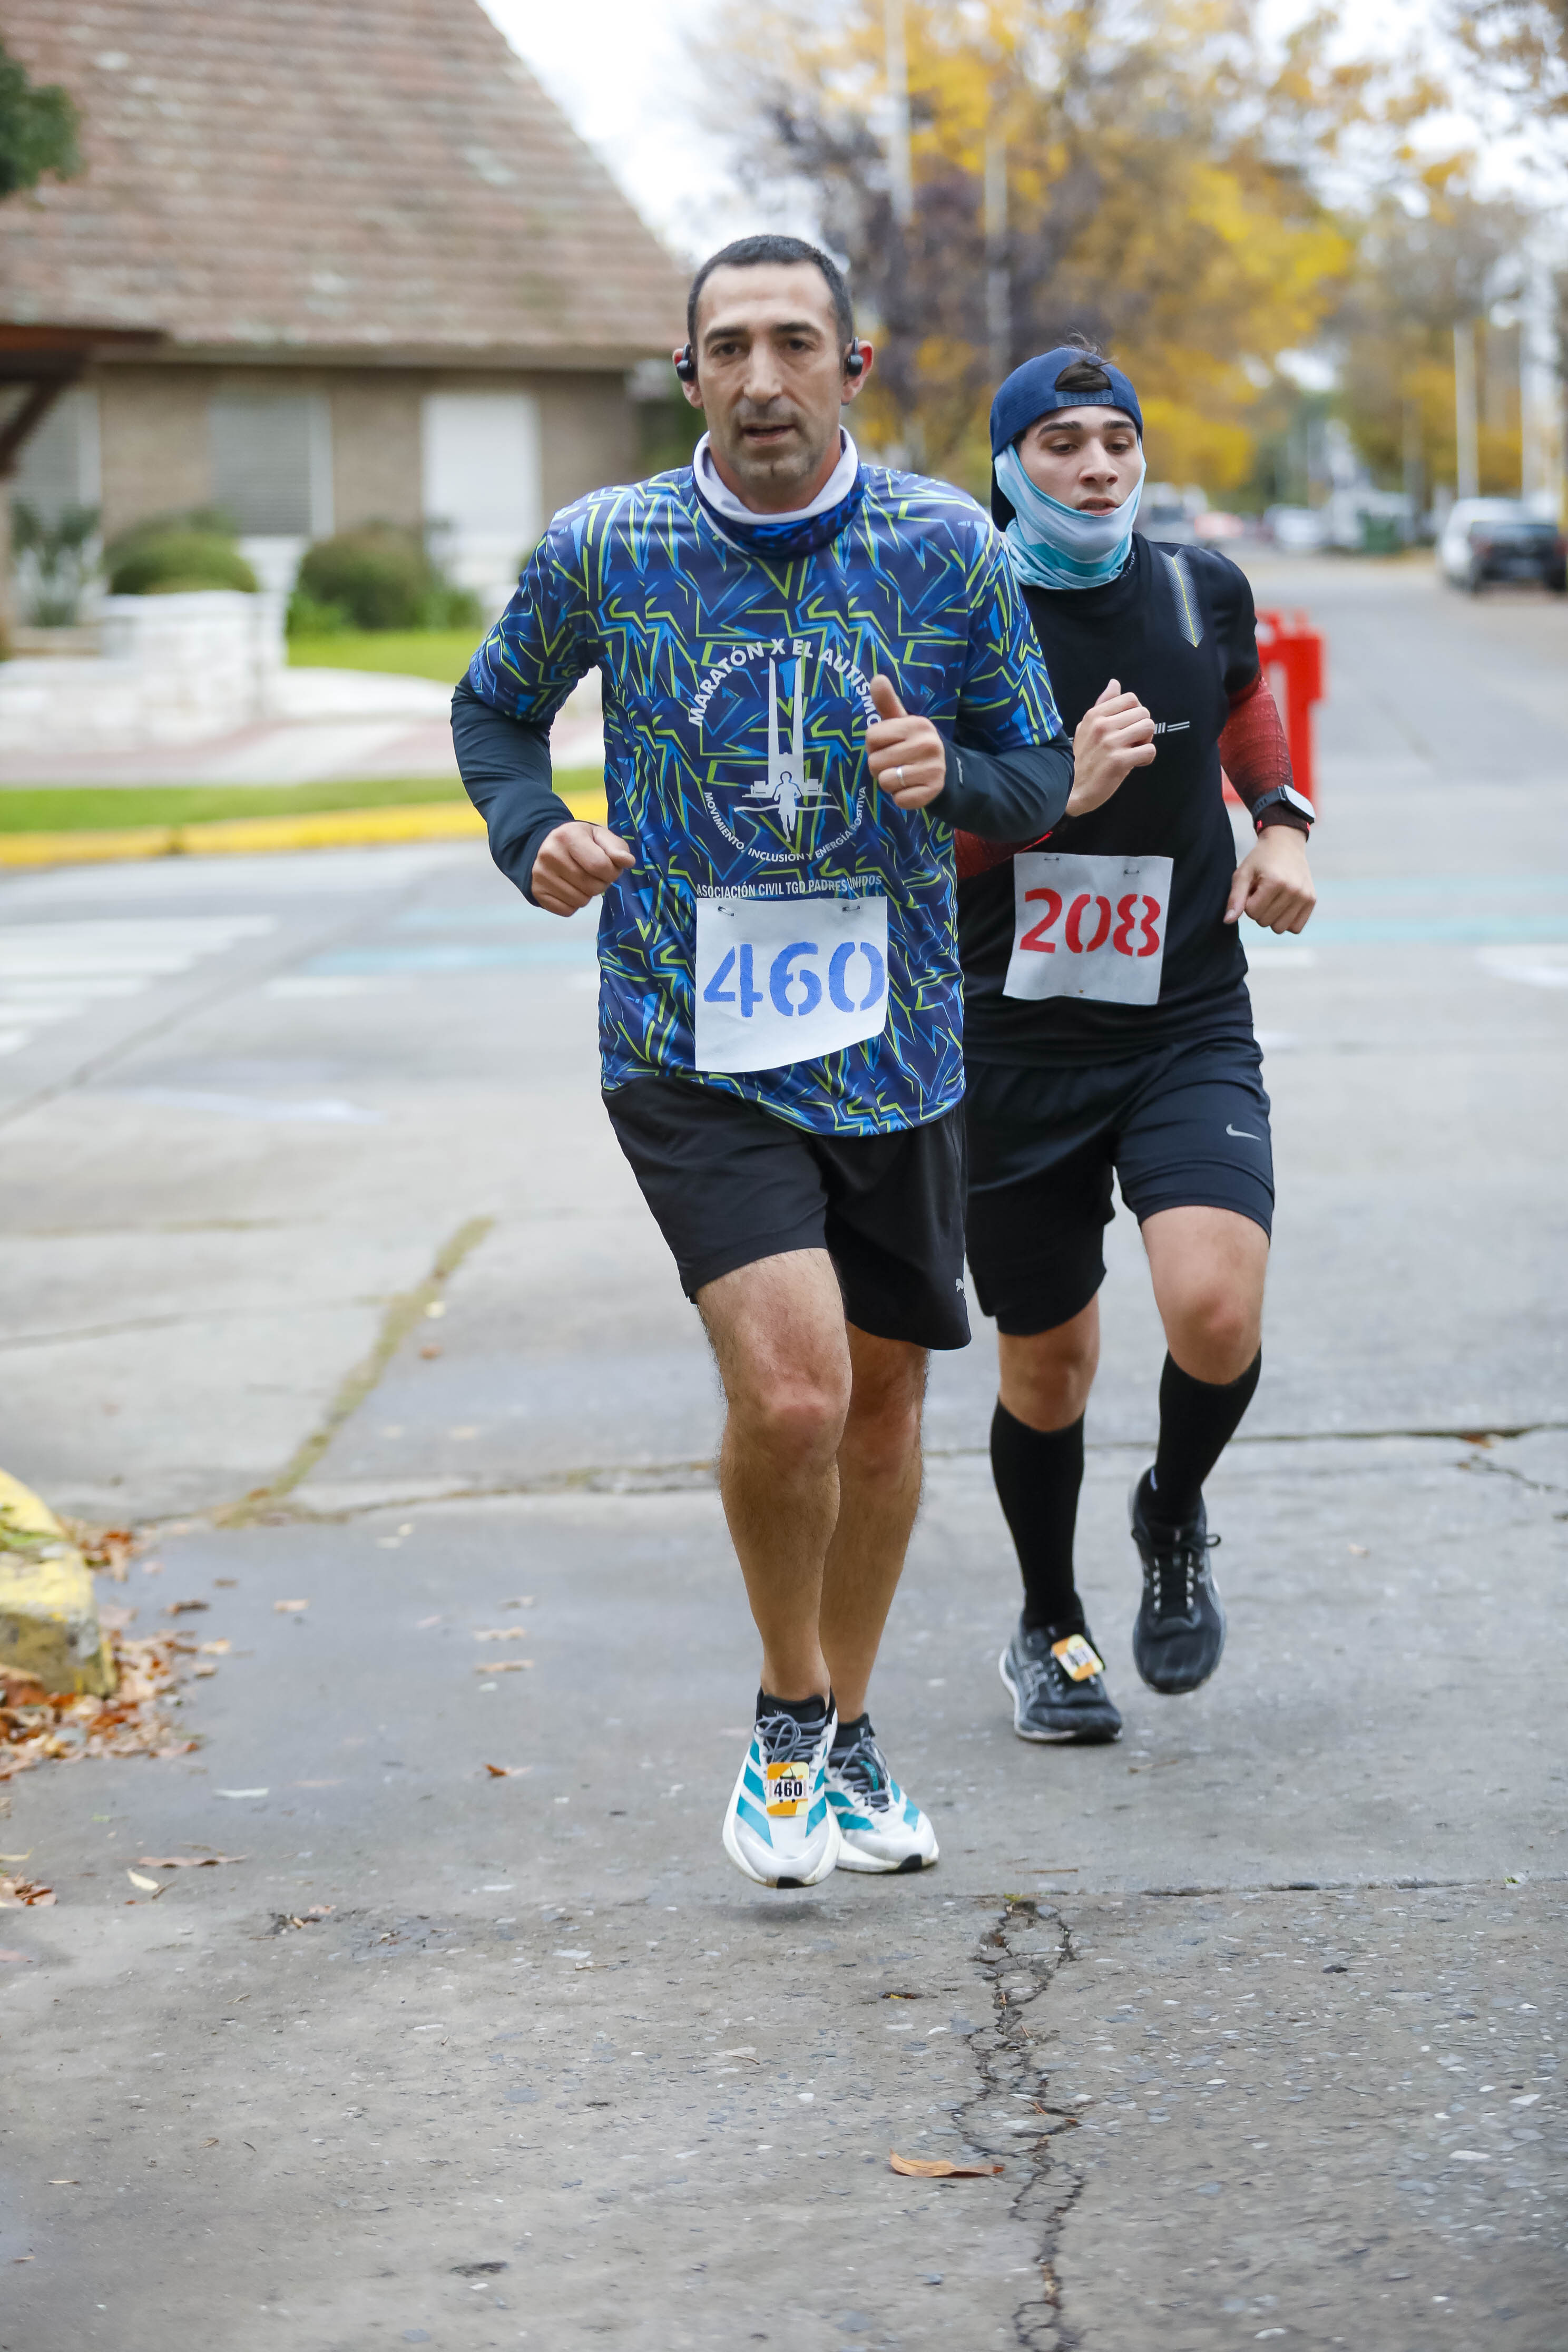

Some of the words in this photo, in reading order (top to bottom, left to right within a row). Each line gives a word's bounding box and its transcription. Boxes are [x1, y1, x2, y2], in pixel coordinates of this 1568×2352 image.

[688, 641, 764, 727] MARATÓN
[771, 638, 786, 654] X
[792, 639, 814, 659] EL
[818, 648, 883, 728] AUTISMO
[748, 848, 805, 862] INCLUSIÓN
[815, 830, 854, 859] ENERGÍA
[850, 786, 867, 832] POSITIVA
[697, 881, 756, 898] ASOCIACIÓN
[758, 883, 785, 896] CIVIL
[786, 880, 806, 894] TGD
[808, 879, 848, 892] PADRES
[847, 875, 882, 890] UNIDOS
[1019, 887, 1161, 957] 208
[703, 941, 885, 1018] 460
[773, 1781, 802, 1797] 460
